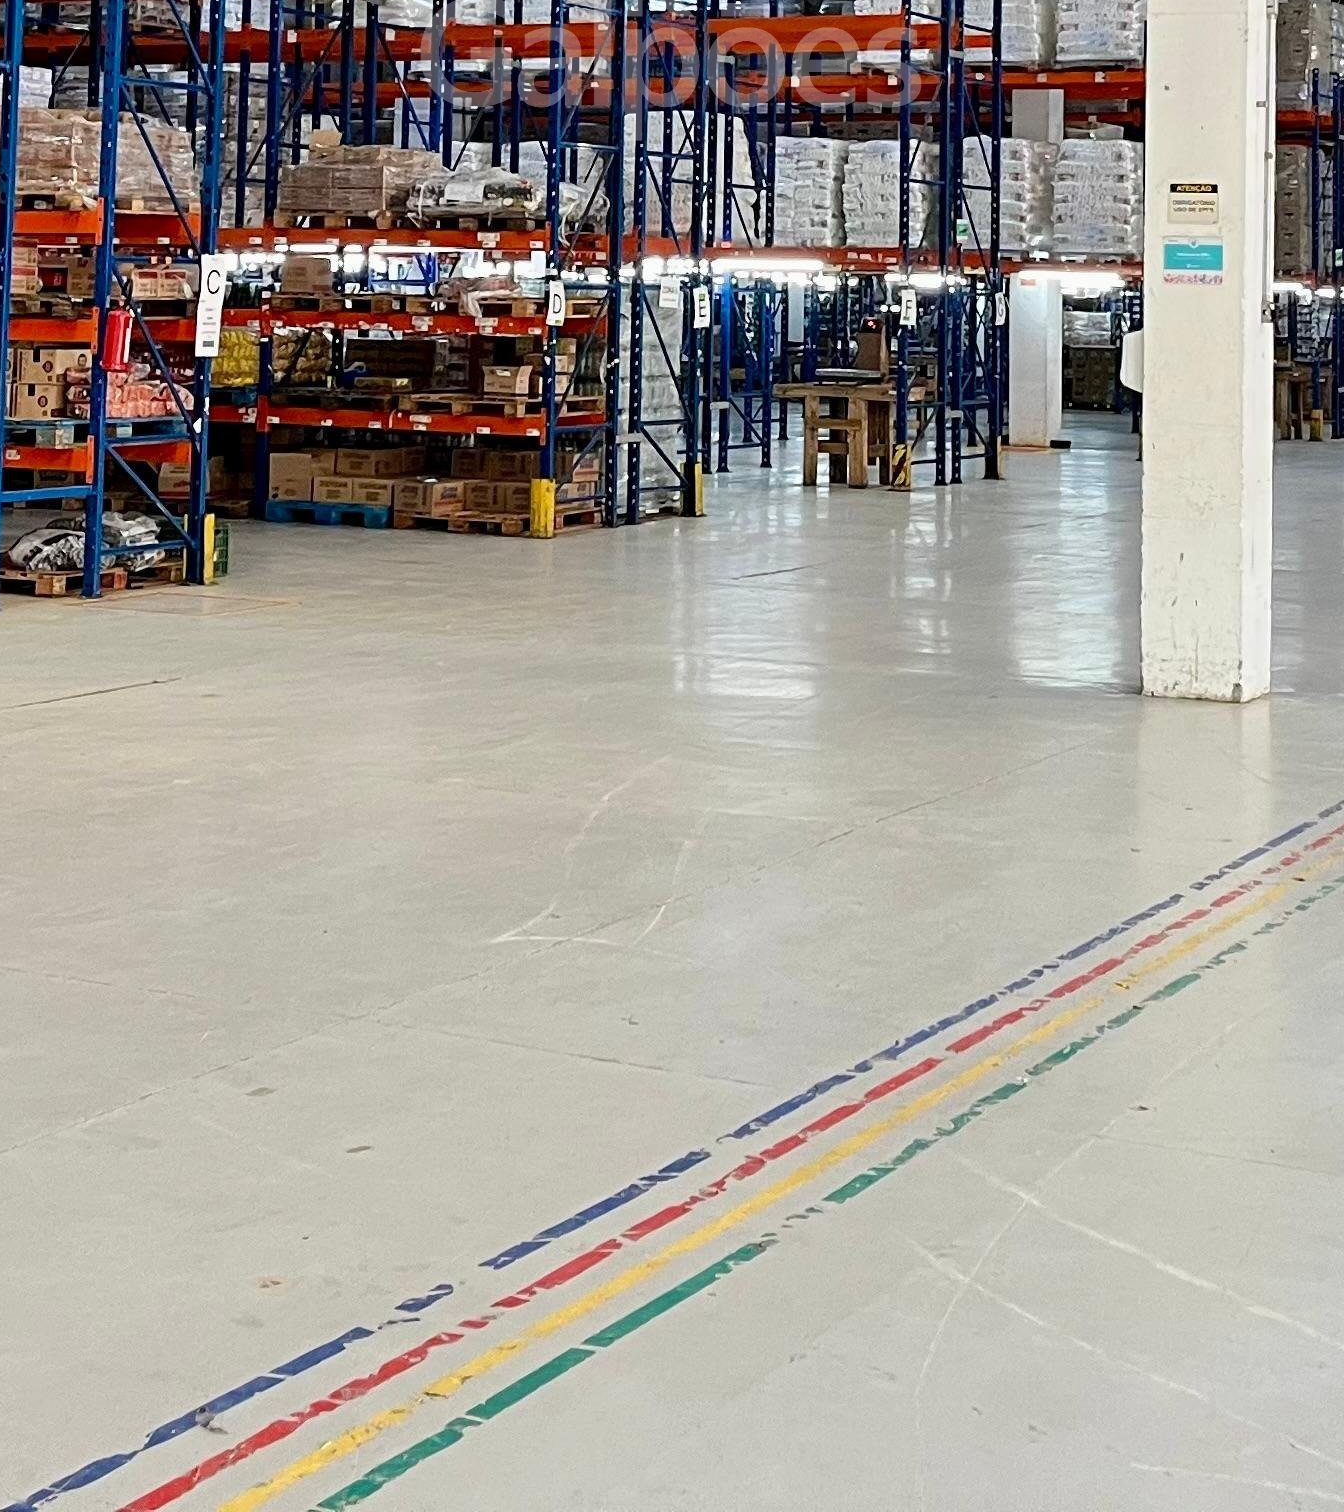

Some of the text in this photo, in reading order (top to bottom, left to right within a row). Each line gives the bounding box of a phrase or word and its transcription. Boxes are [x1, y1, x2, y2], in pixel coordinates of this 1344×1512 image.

[206, 269, 221, 295] C
[552, 293, 562, 314] D
[698, 299, 707, 317] E
[905, 299, 913, 317] F
